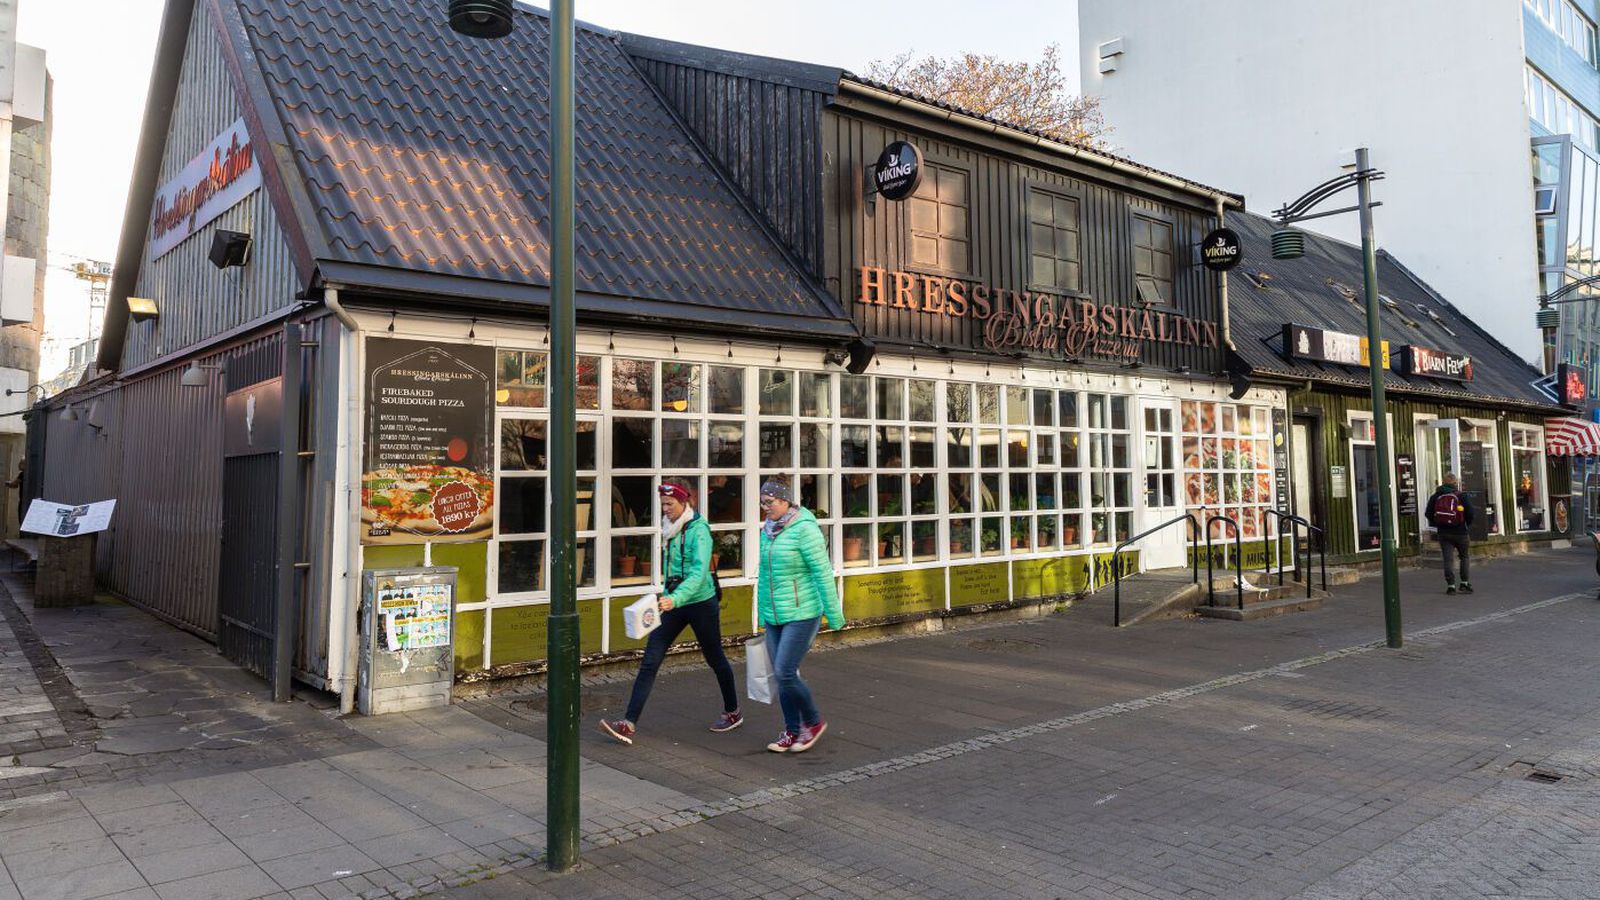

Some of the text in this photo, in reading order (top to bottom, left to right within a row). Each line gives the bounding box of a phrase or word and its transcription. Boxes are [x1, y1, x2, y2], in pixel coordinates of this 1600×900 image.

[858, 264, 1219, 349] HRESSINGARSKÁLINN
[983, 311, 1140, 357] Bistro Pizzeria
[382, 387, 434, 397] FIREBAKED
[381, 396, 465, 407] SOURDOUGH PIZZA
[441, 511, 463, 524] 1890
